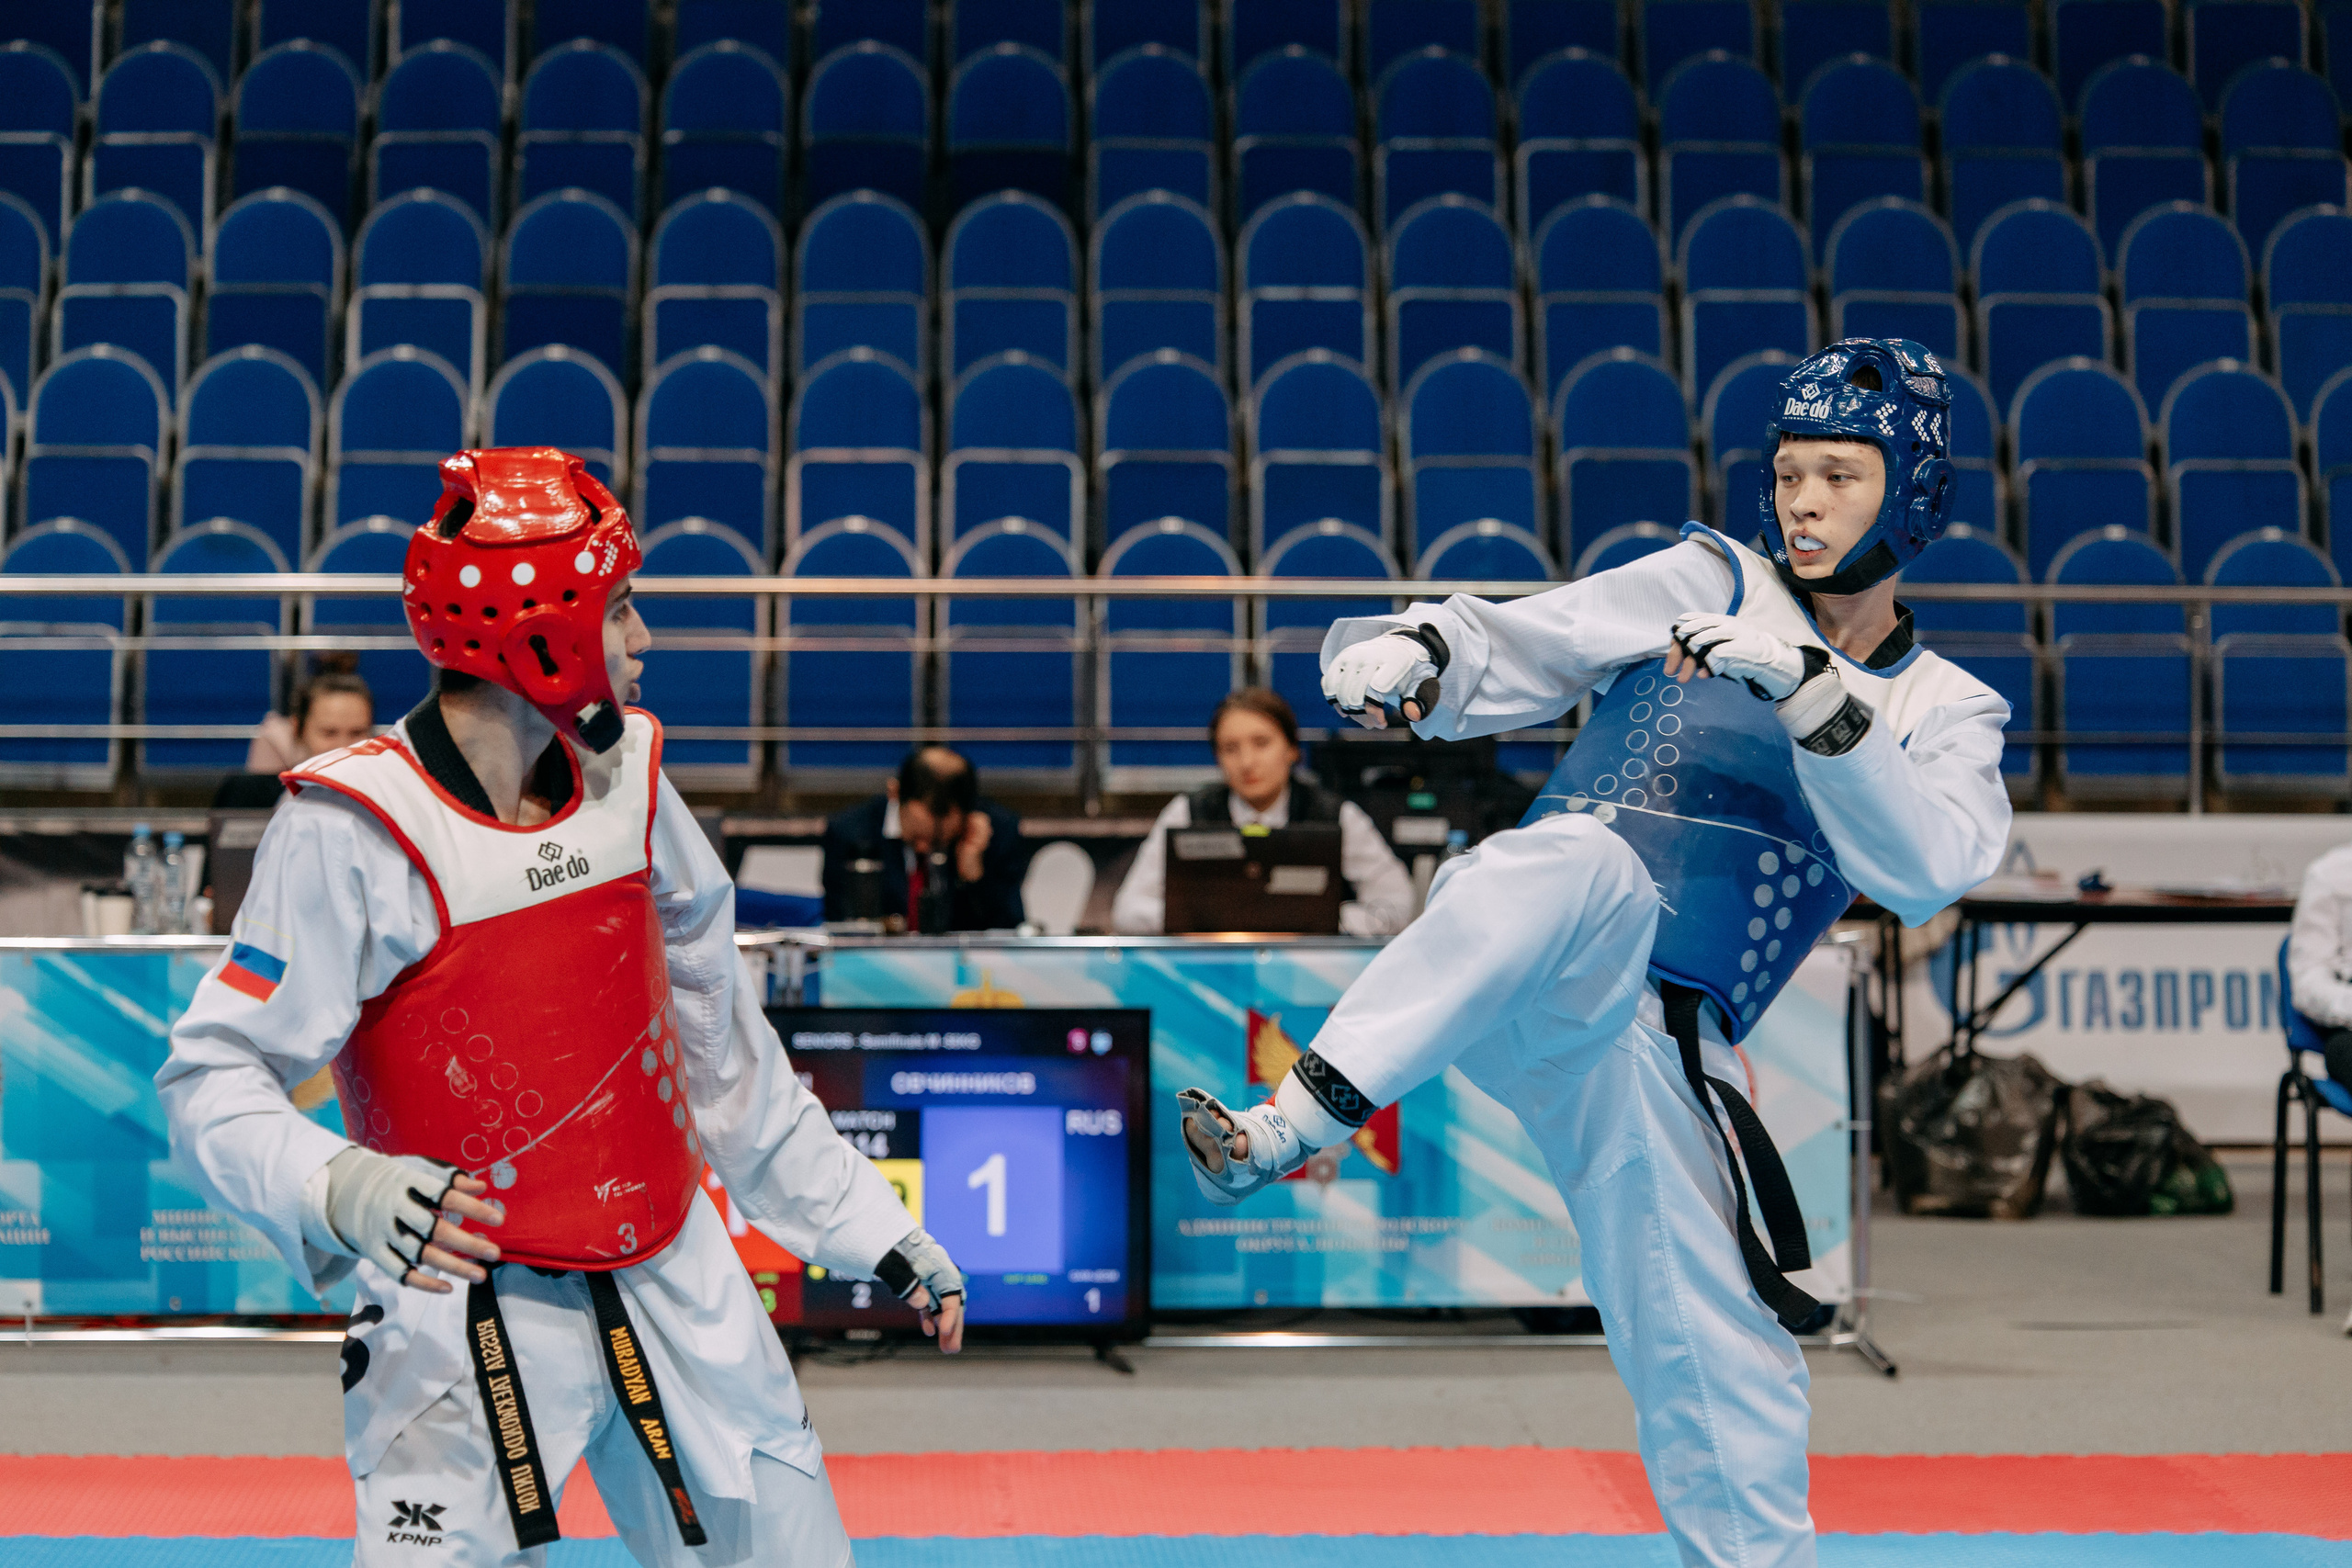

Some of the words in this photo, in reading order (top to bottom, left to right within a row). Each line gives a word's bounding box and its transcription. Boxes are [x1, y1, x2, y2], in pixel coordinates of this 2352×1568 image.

[1066, 1109, 1123, 1135] RUS
[967, 1153, 1007, 1237] 1
[617, 1223, 638, 1255] 3
[851, 1282, 872, 1309] 2
[1084, 1287, 1102, 1314] 1
[609, 1325, 652, 1405] MURADYAN
[639, 1417, 672, 1460] ARAM
[387, 1531, 442, 1547] KPNP
